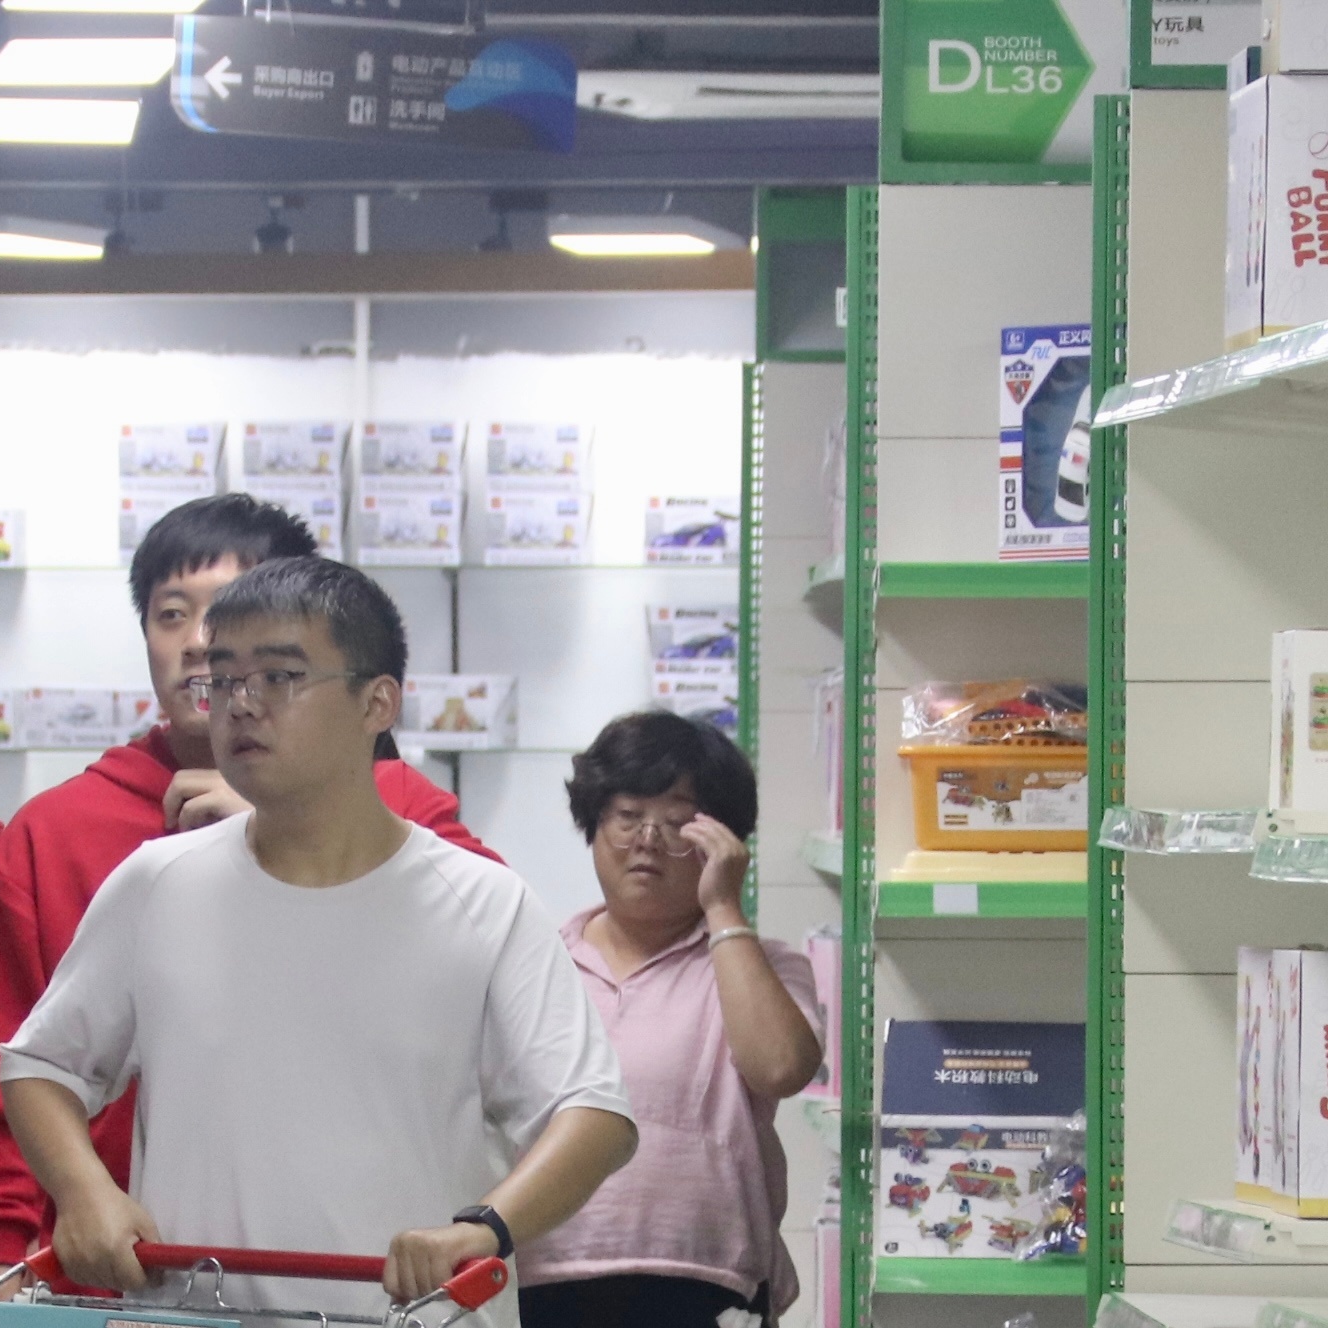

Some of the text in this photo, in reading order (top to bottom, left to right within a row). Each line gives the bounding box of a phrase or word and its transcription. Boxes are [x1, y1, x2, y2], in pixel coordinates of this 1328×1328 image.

[984, 37, 1042, 49] BOOTH
[984, 50, 1058, 62] NUMBER
[928, 40, 981, 93] D
[984, 66, 1063, 94] L36
[1286, 186, 1317, 267] BALL
